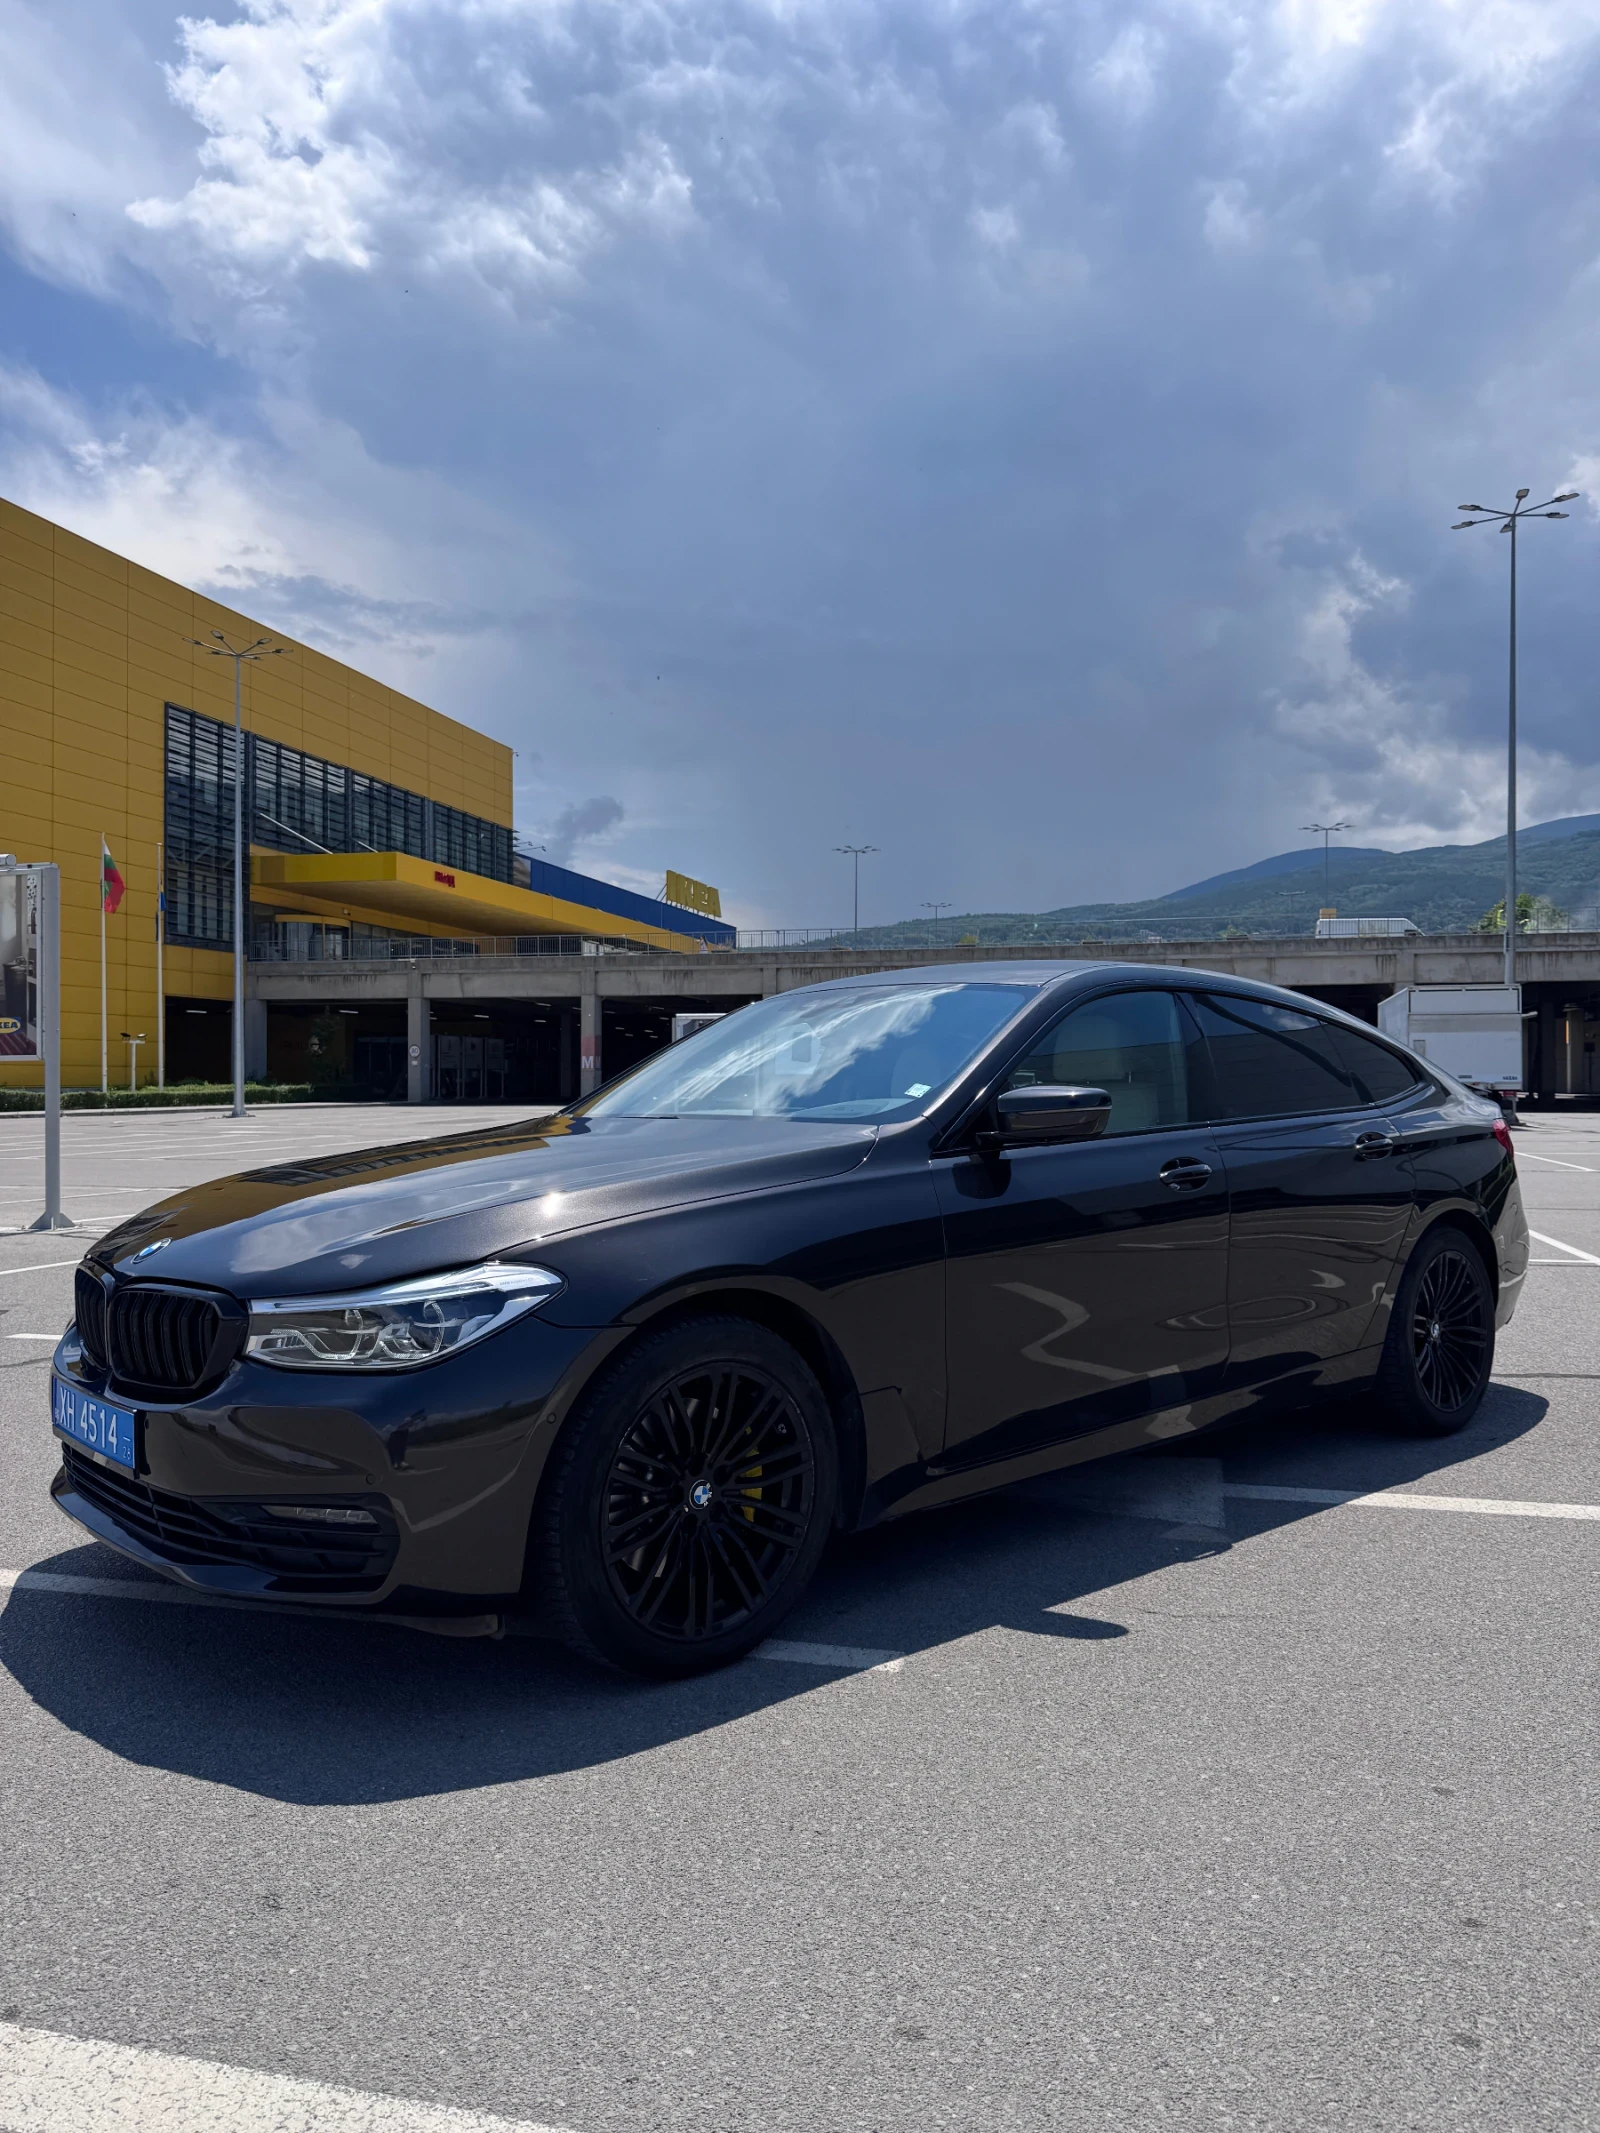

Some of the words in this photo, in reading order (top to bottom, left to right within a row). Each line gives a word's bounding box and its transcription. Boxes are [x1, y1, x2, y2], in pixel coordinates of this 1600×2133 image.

[666, 869, 722, 918] IKEA
[581, 1055, 594, 1069] M
[60, 1385, 76, 1432] XH
[80, 1400, 118, 1454] 4514
